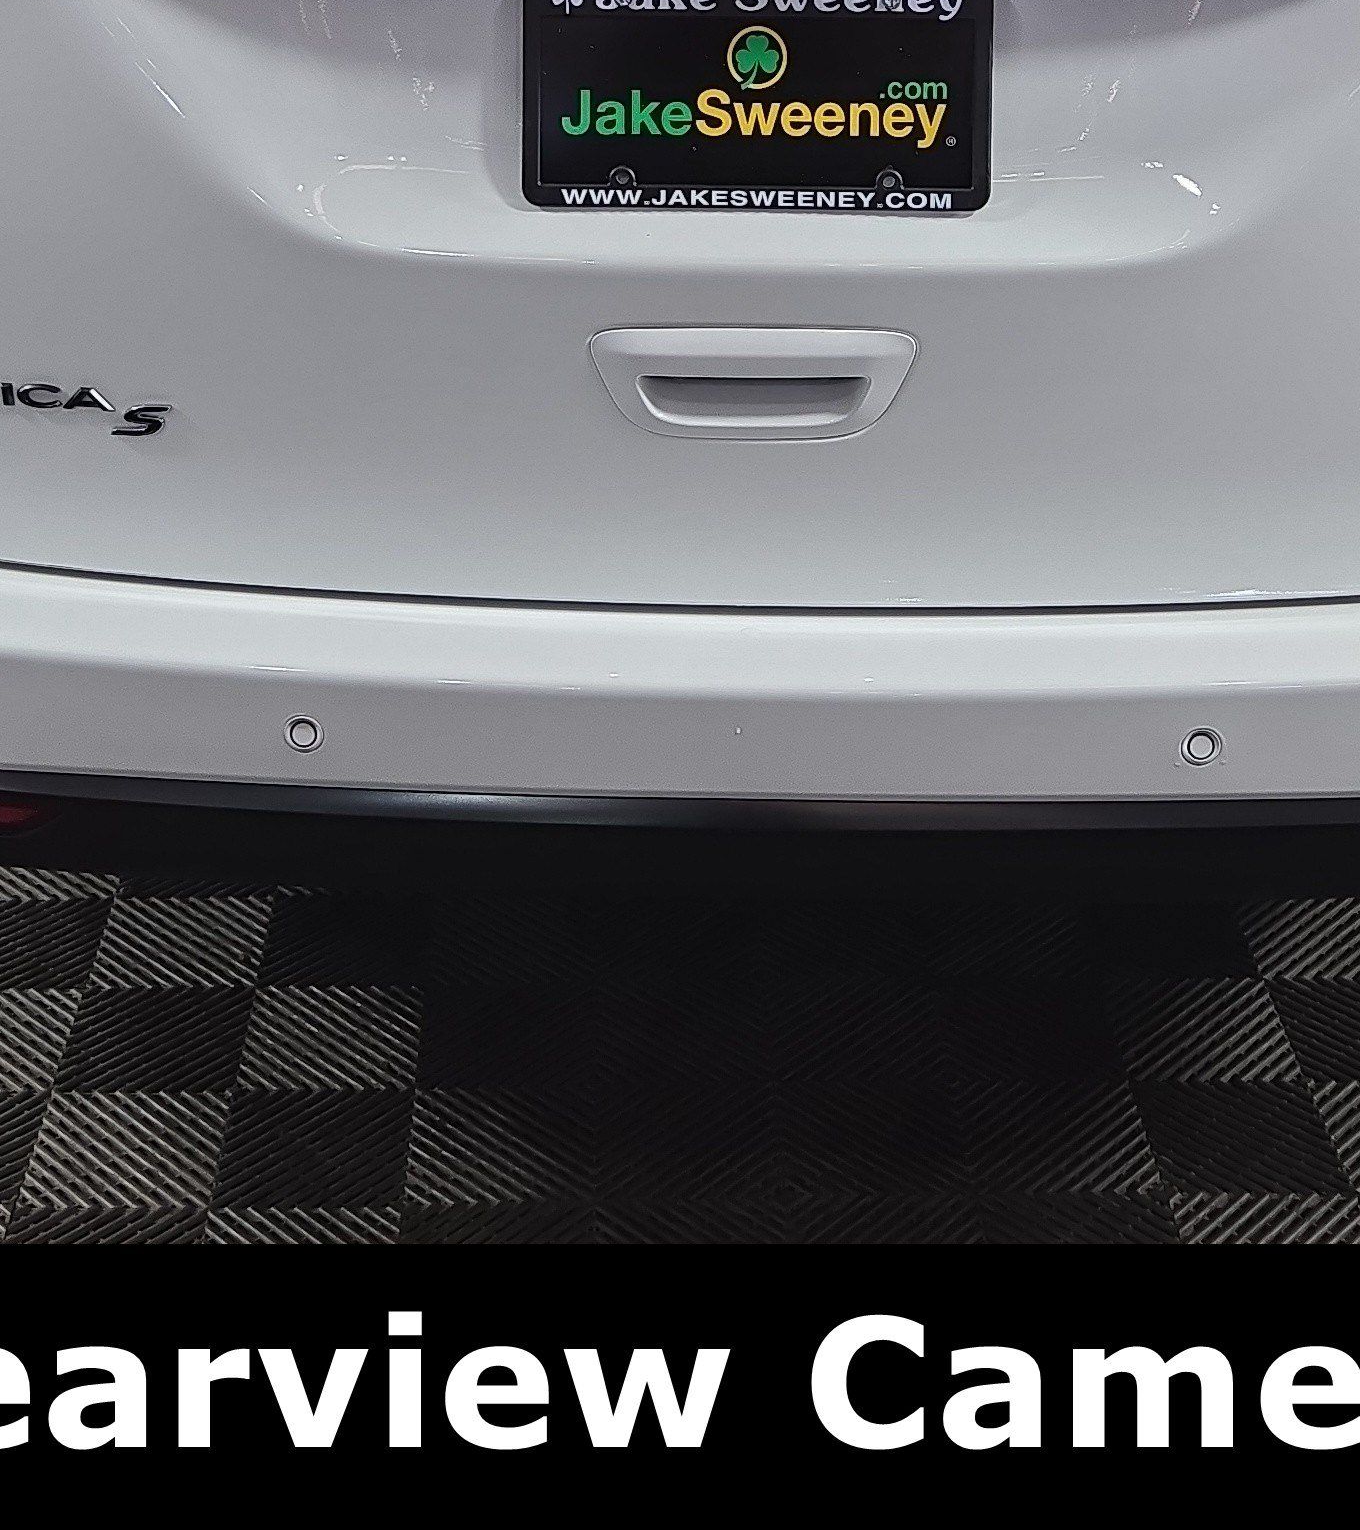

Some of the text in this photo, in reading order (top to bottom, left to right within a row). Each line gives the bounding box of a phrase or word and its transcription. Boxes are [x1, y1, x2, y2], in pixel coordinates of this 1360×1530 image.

[879, 81, 947, 100] .com
[561, 188, 952, 209] WWW.JAKESWEENEY.COM
[111, 404, 172, 437] S
